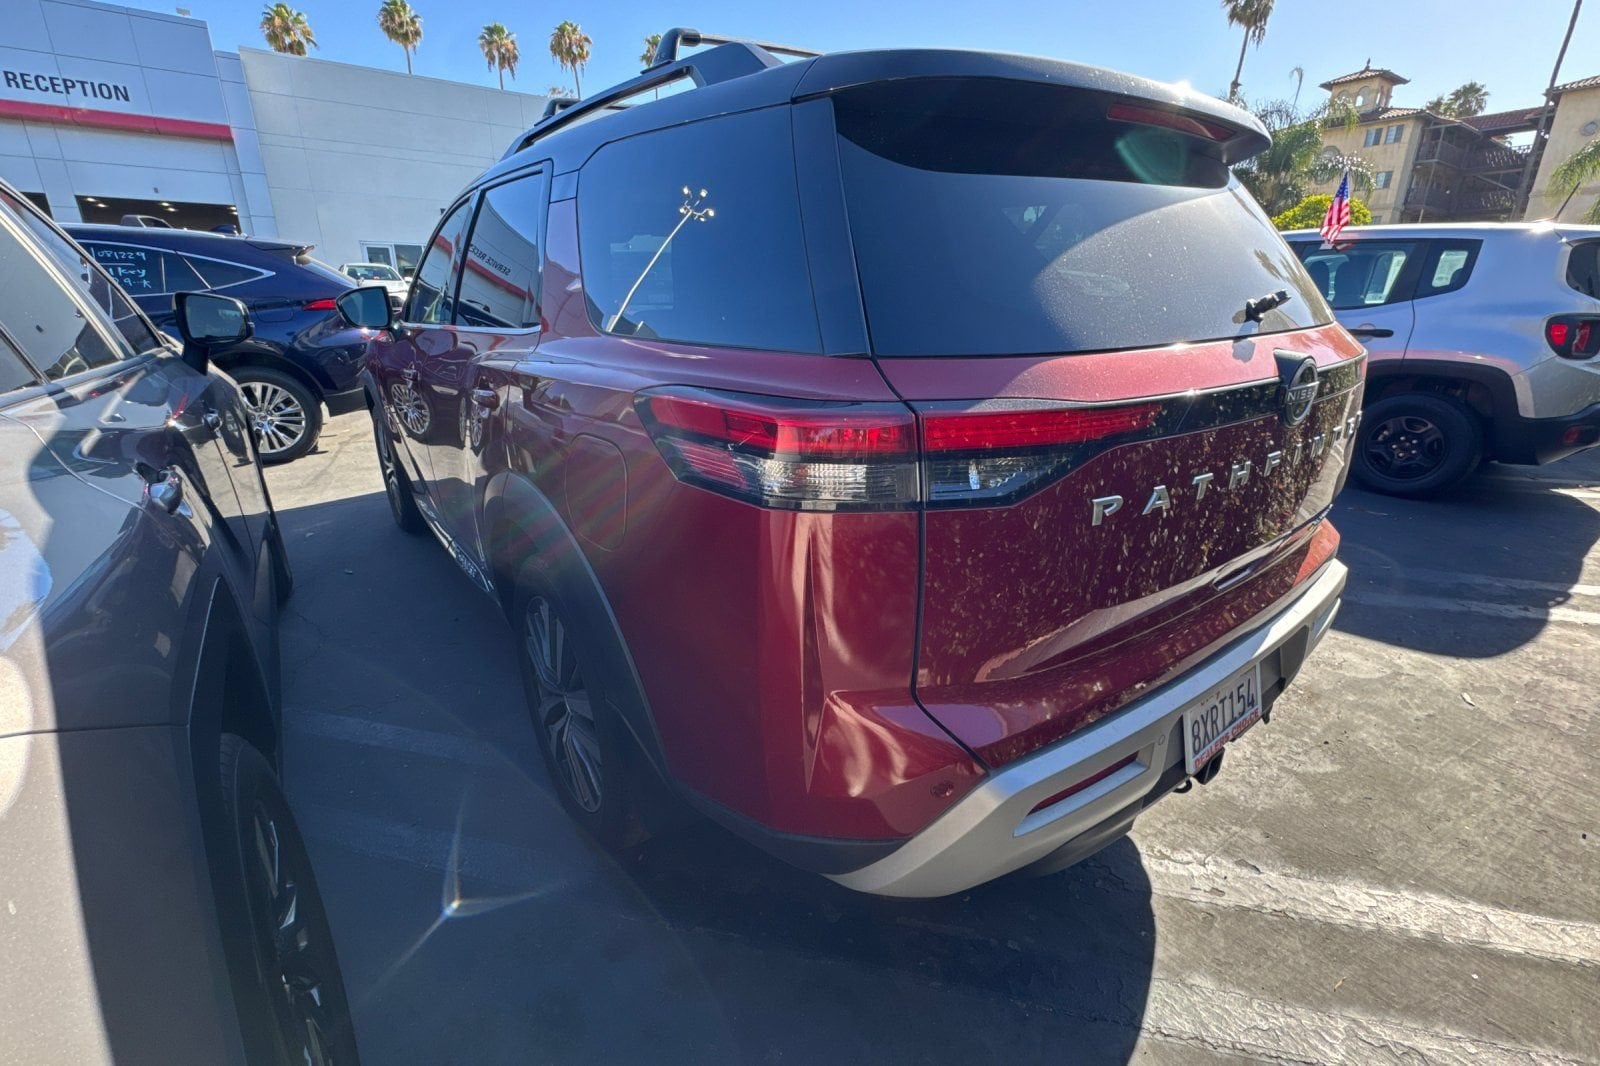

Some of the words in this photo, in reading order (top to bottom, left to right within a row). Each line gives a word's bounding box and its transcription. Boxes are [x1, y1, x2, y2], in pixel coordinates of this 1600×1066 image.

[3, 70, 131, 102] RECEPTION
[1286, 388, 1315, 401] NISS
[1192, 678, 1255, 755] 8XRT154
[1231, 708, 1259, 737] CHOICE
